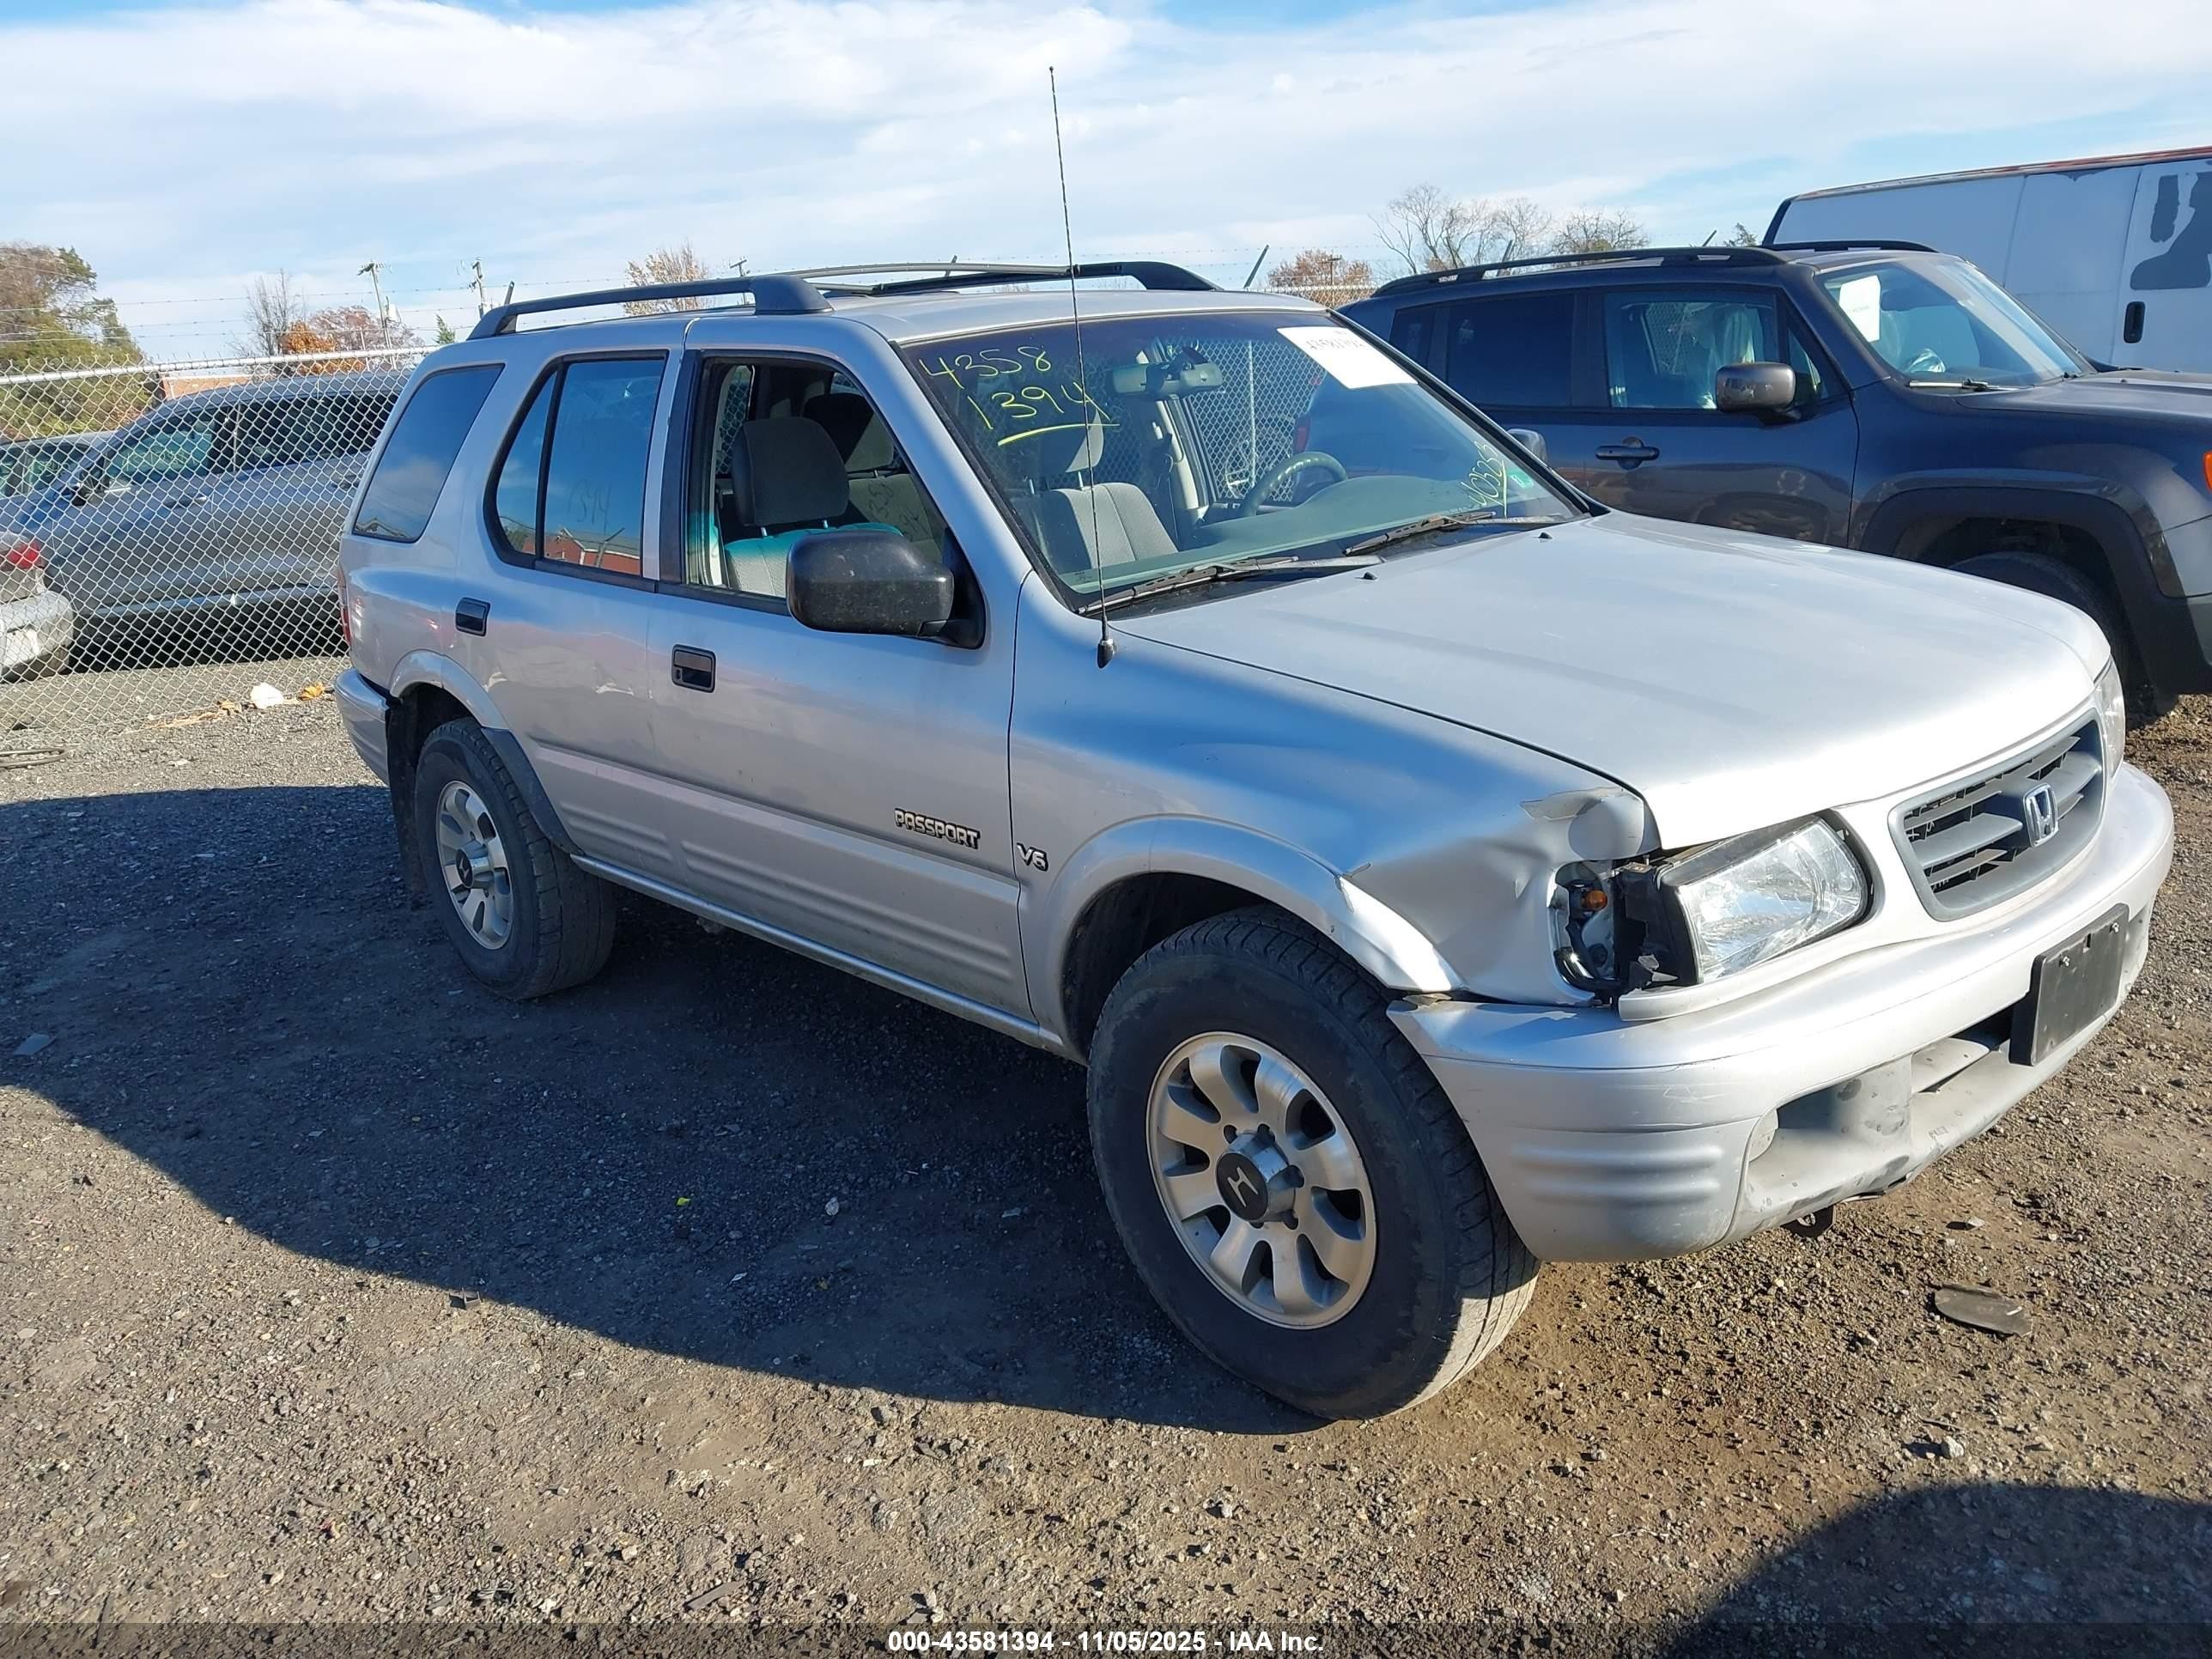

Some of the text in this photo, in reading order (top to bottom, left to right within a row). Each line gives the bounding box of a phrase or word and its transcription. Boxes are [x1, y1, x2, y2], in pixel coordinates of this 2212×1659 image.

[919, 346, 1051, 390] 4358
[967, 381, 1111, 430] 1394
[894, 807, 981, 850] PASSPORT
[1017, 842, 1048, 872] V6
